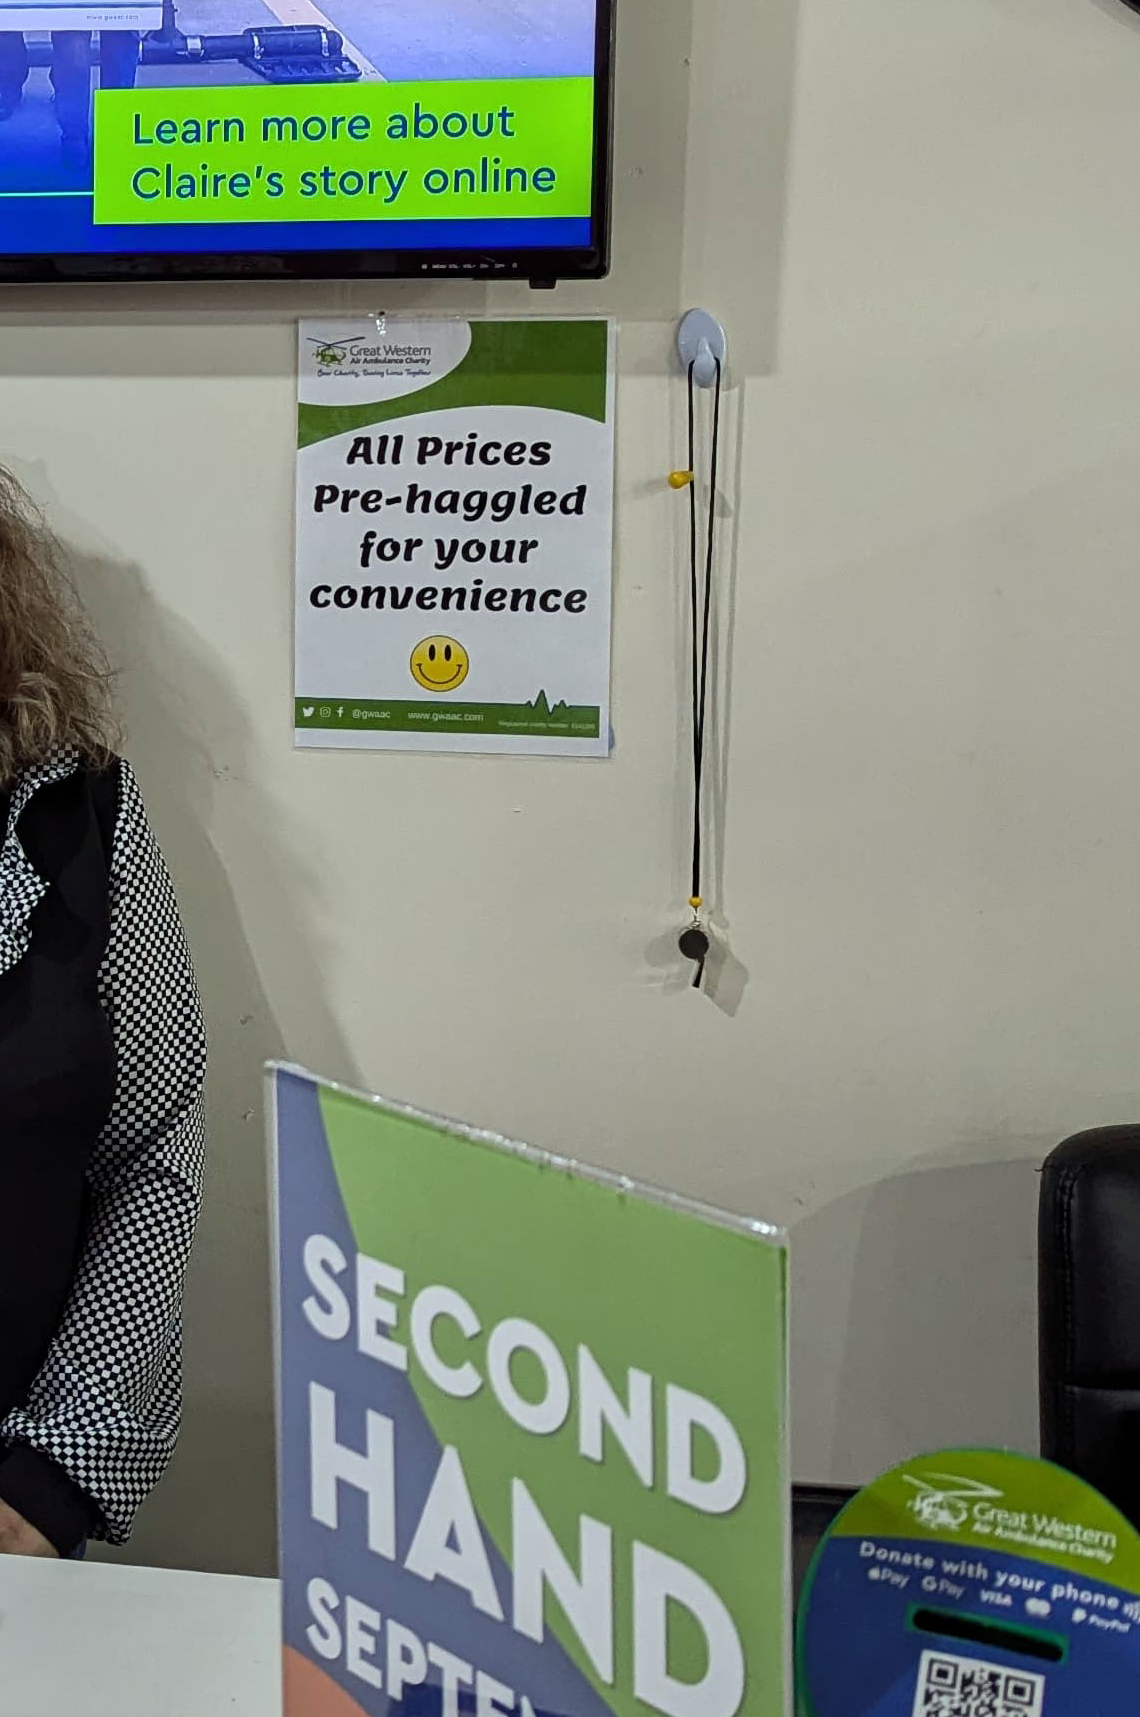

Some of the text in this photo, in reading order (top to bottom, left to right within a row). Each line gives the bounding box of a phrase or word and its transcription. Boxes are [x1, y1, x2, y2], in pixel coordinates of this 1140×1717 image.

[133, 103, 515, 144] Learn more about
[132, 157, 556, 203] Claire's story online
[350, 345, 431, 357] Great Western
[405, 357, 431, 365] Charity
[346, 433, 552, 465] All Prices
[313, 483, 587, 522] Pre-haggled
[360, 531, 539, 570] for your
[310, 579, 587, 613] convenience
[352, 708, 484, 721] @gwaac www.gwaac.com
[302, 1233, 747, 1514] SECOND
[973, 1501, 1117, 1549] Great Western
[309, 1380, 745, 1717] HAND
[1069, 1542, 1114, 1564] Charity
[859, 1541, 1120, 1609] Donate with your phone
[980, 1589, 1013, 1607] VISA
[1088, 1613, 1131, 1634] PayPal
